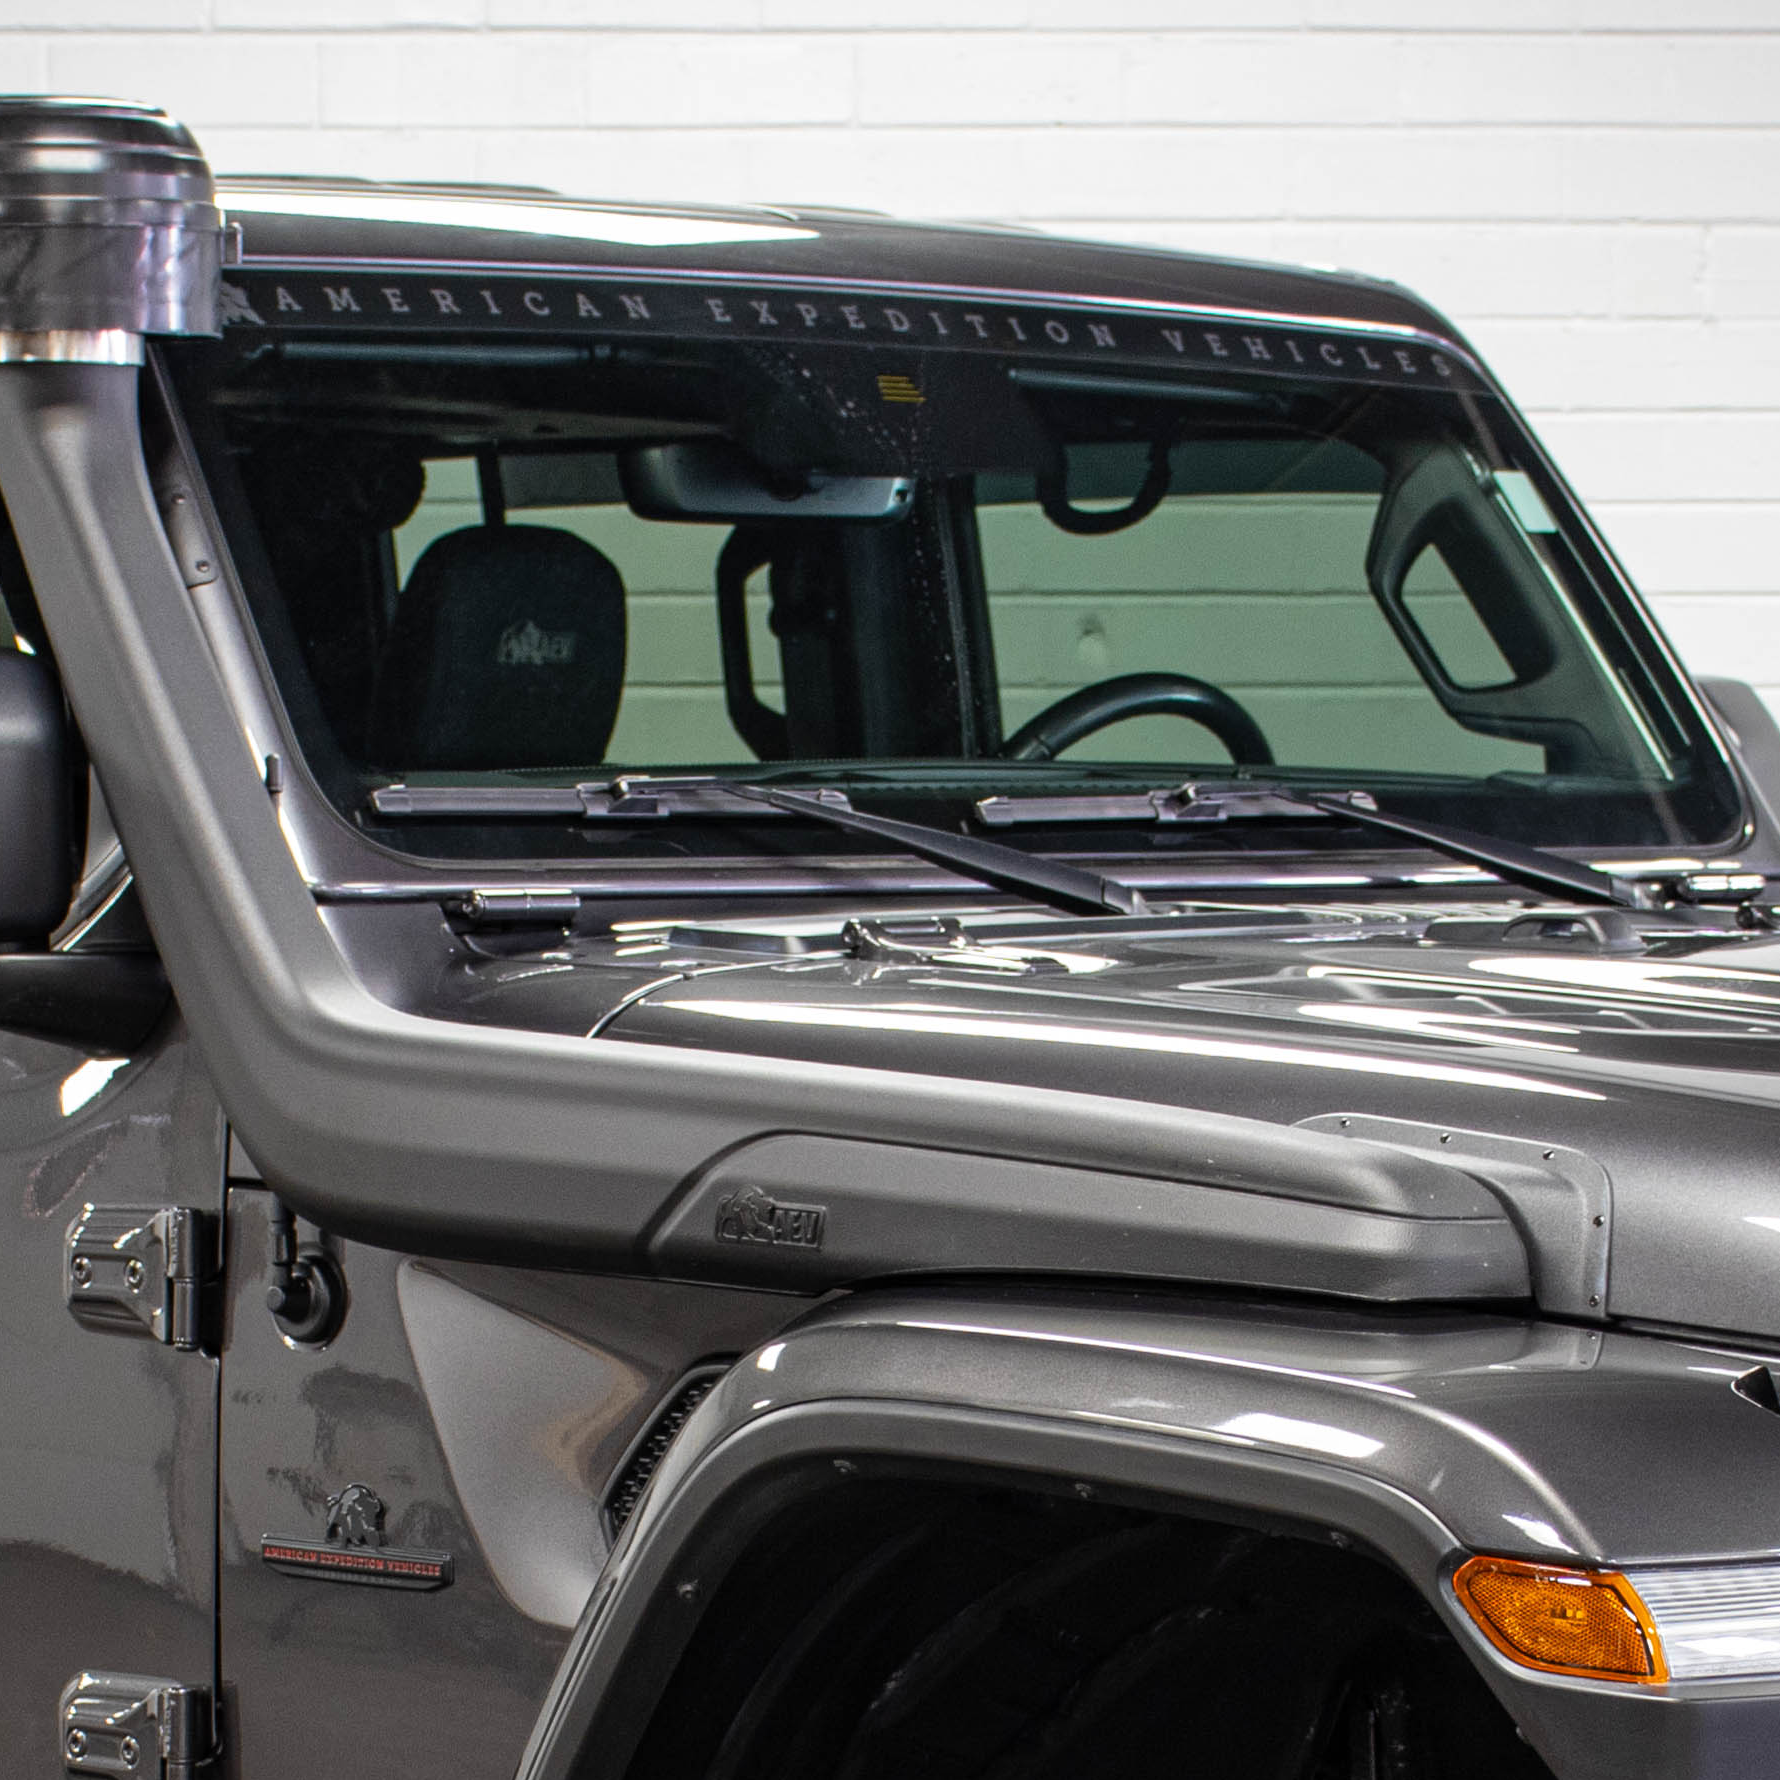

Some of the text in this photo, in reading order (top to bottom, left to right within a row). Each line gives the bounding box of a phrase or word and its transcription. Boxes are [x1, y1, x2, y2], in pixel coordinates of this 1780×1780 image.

[274, 285, 1452, 377] AMERICAN EXPEDITION VEHICLES
